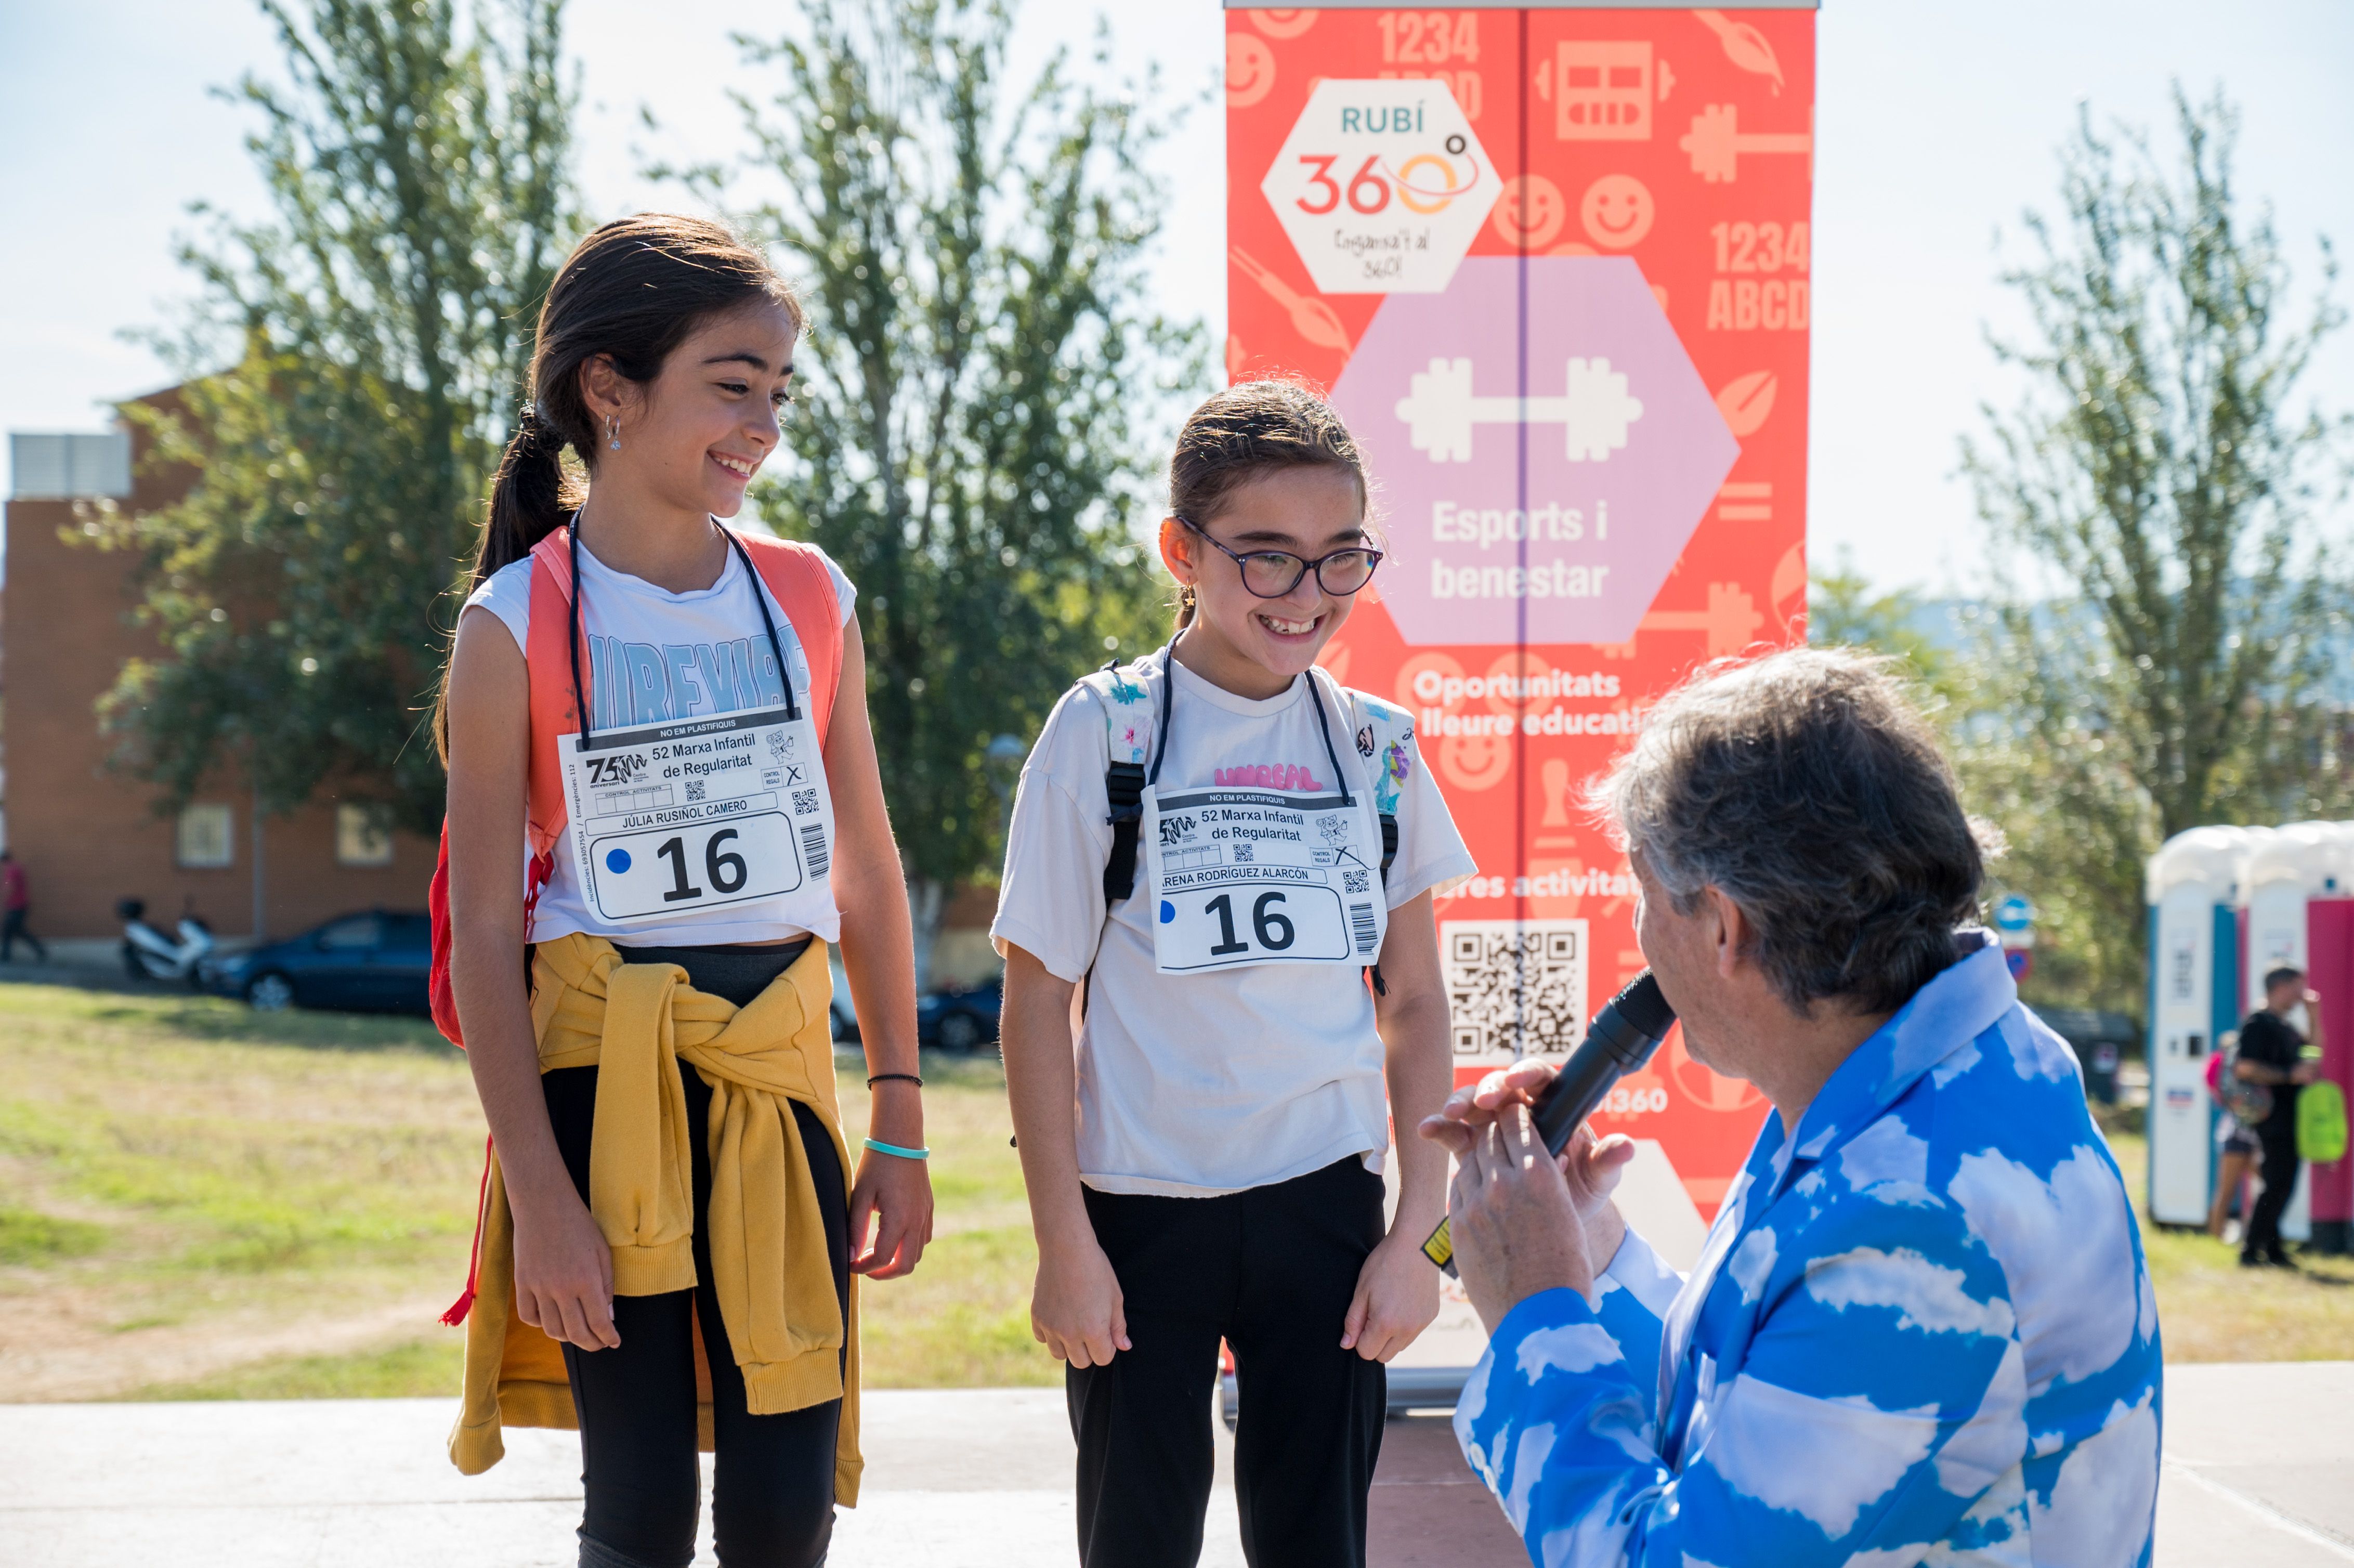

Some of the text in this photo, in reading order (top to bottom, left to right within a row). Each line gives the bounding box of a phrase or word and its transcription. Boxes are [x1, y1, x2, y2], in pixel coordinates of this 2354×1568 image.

[1377, 11, 1481, 63] 1234
[1341, 99, 1426, 134] RUBÍ
[1710, 221, 1811, 272] 1234
[1707, 279, 1811, 331] ABCD
[1432, 499, 1608, 550] Esports i
[1431, 558, 1611, 599] benestar
[1413, 668, 1620, 707] Oportunitats
[660, 720, 736, 738] NO EM PLASTIFIQUIS
[1421, 707, 1514, 737] lleure
[1522, 705, 1648, 736] educati
[652, 734, 756, 760] 52 Marxa Infantil
[663, 753, 753, 778] de Regularitat
[1214, 763, 1323, 791] UNREAL
[572, 777, 581, 818] Emergències:
[623, 800, 748, 828] JÚLIA RUSIÑOL CAMERO
[1237, 795, 1286, 804] PLASTIFIQUIS
[1201, 809, 1304, 826] 52 Marxa Infantil
[1212, 827, 1301, 841] de Regularitat
[578, 831, 588, 865] 693057554
[657, 828, 748, 902] 16
[584, 866, 594, 902] Incidències:
[1197, 867, 1260, 882] RODRÍGUEZ
[1262, 867, 1309, 880] ALARCÓN
[1512, 868, 1641, 897] activitat
[1205, 891, 1295, 956] 16
